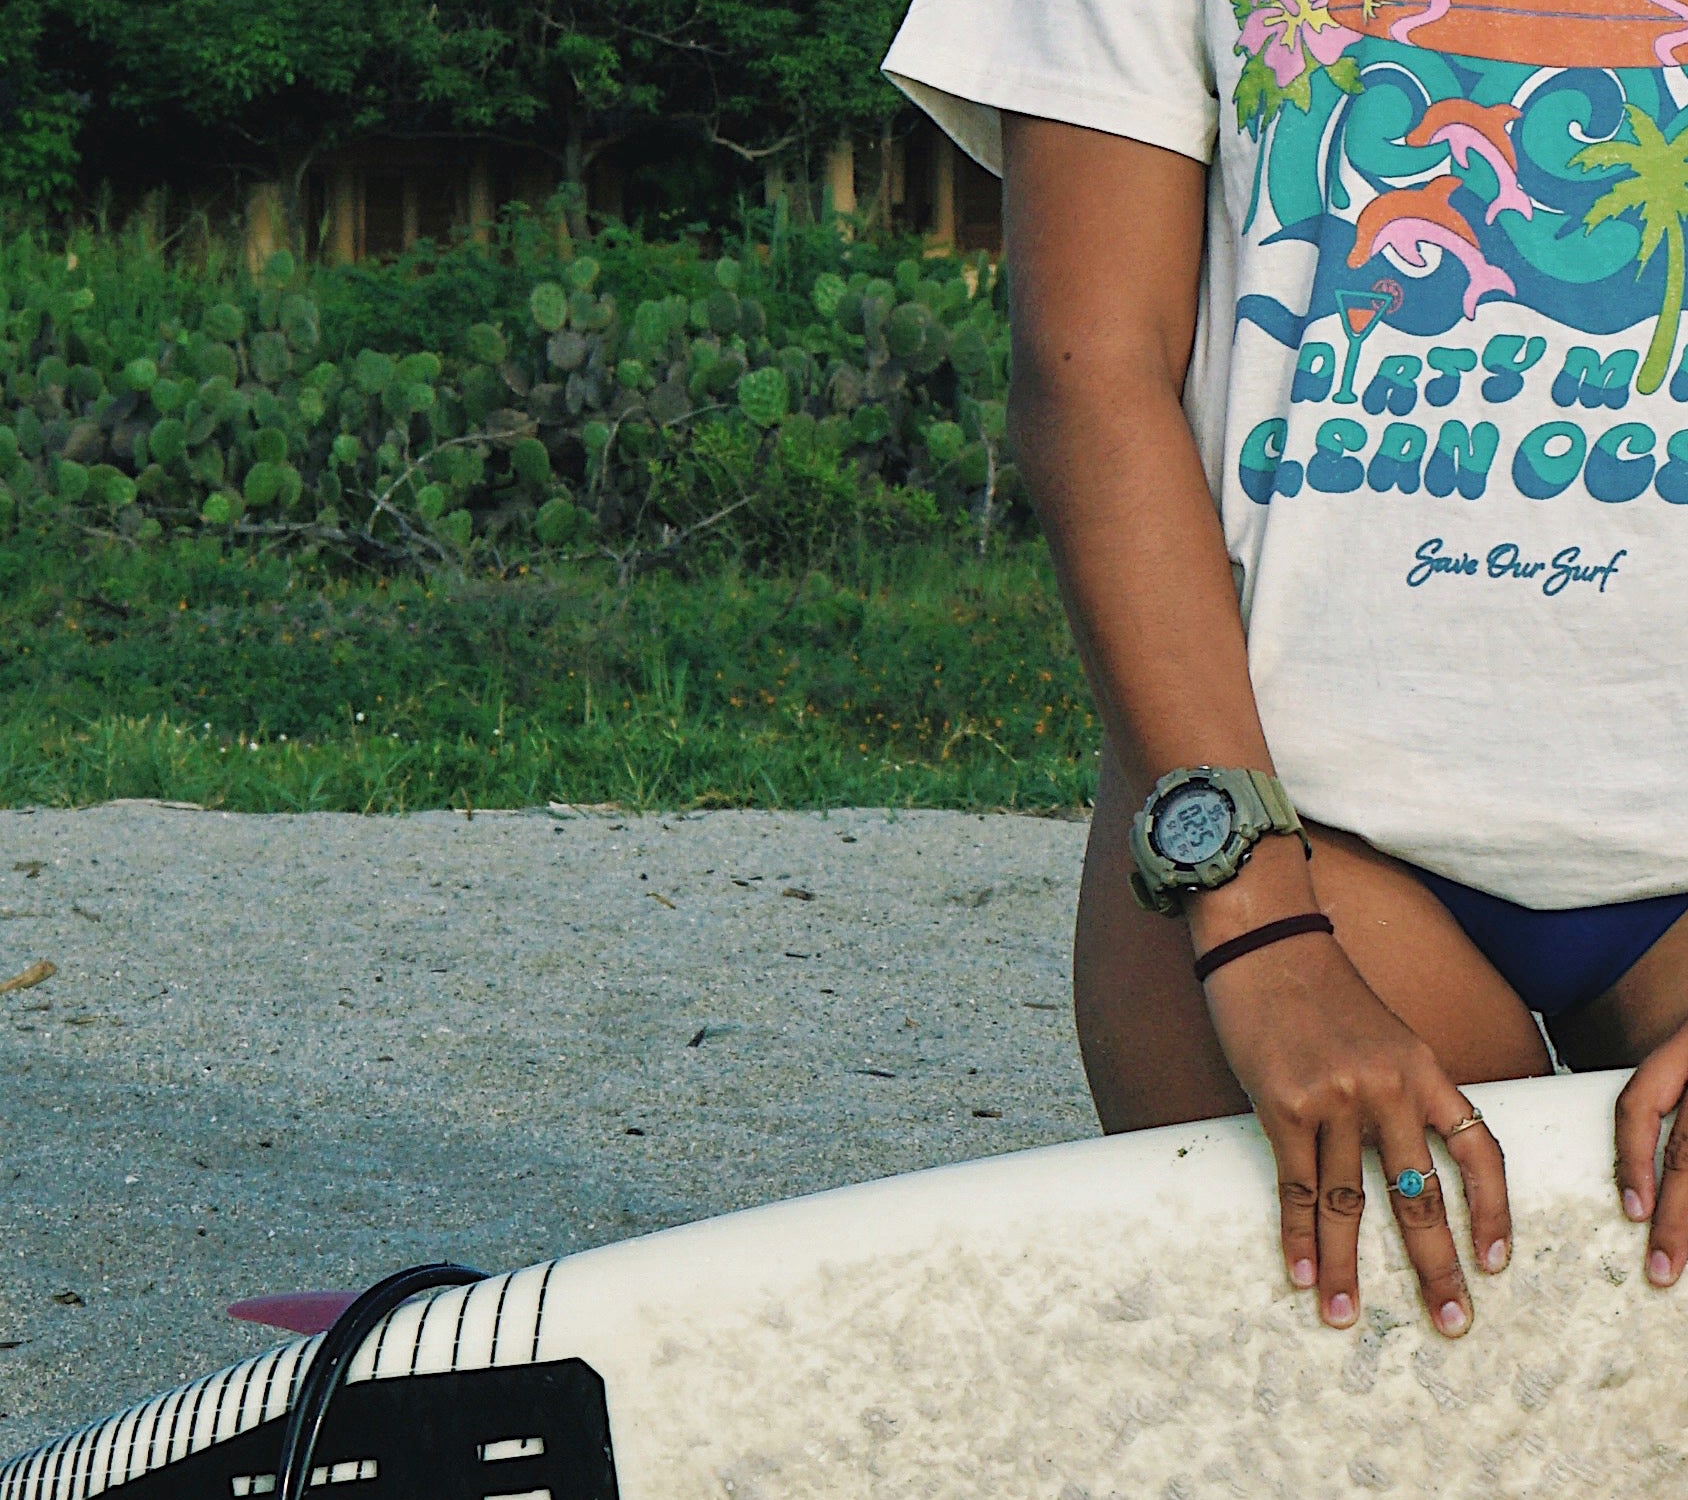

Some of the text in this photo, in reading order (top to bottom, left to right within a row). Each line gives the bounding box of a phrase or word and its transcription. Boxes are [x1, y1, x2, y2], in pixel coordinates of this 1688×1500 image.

[1406, 537, 1628, 597] Save Our Surf
